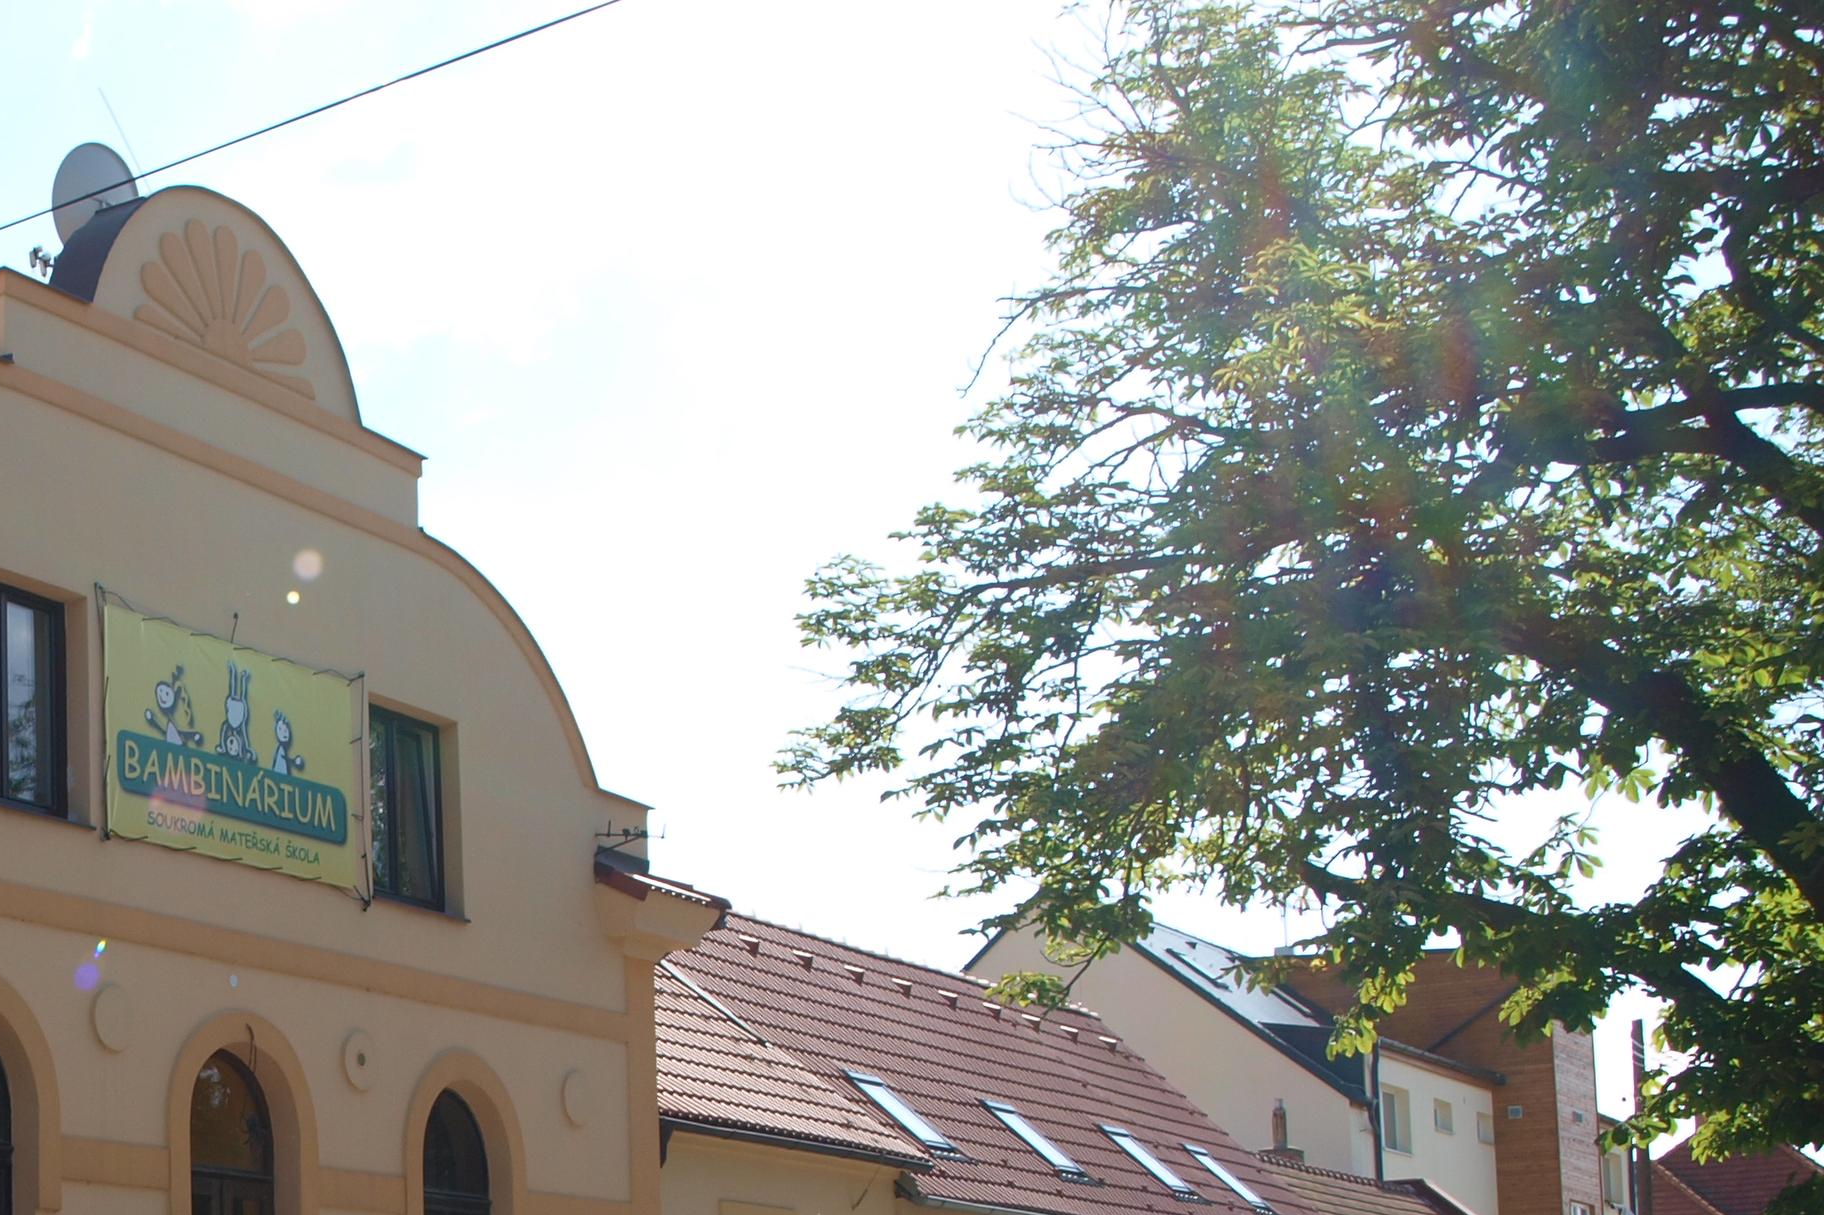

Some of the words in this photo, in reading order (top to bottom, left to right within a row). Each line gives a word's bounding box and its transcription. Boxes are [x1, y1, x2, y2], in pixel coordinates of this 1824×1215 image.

[124, 740, 336, 832] BAMBINÁRIUM
[147, 811, 215, 838] SOUKROMÁ
[219, 828, 280, 856] MATEŘSKÁ
[285, 844, 320, 864] ŠKOLA
